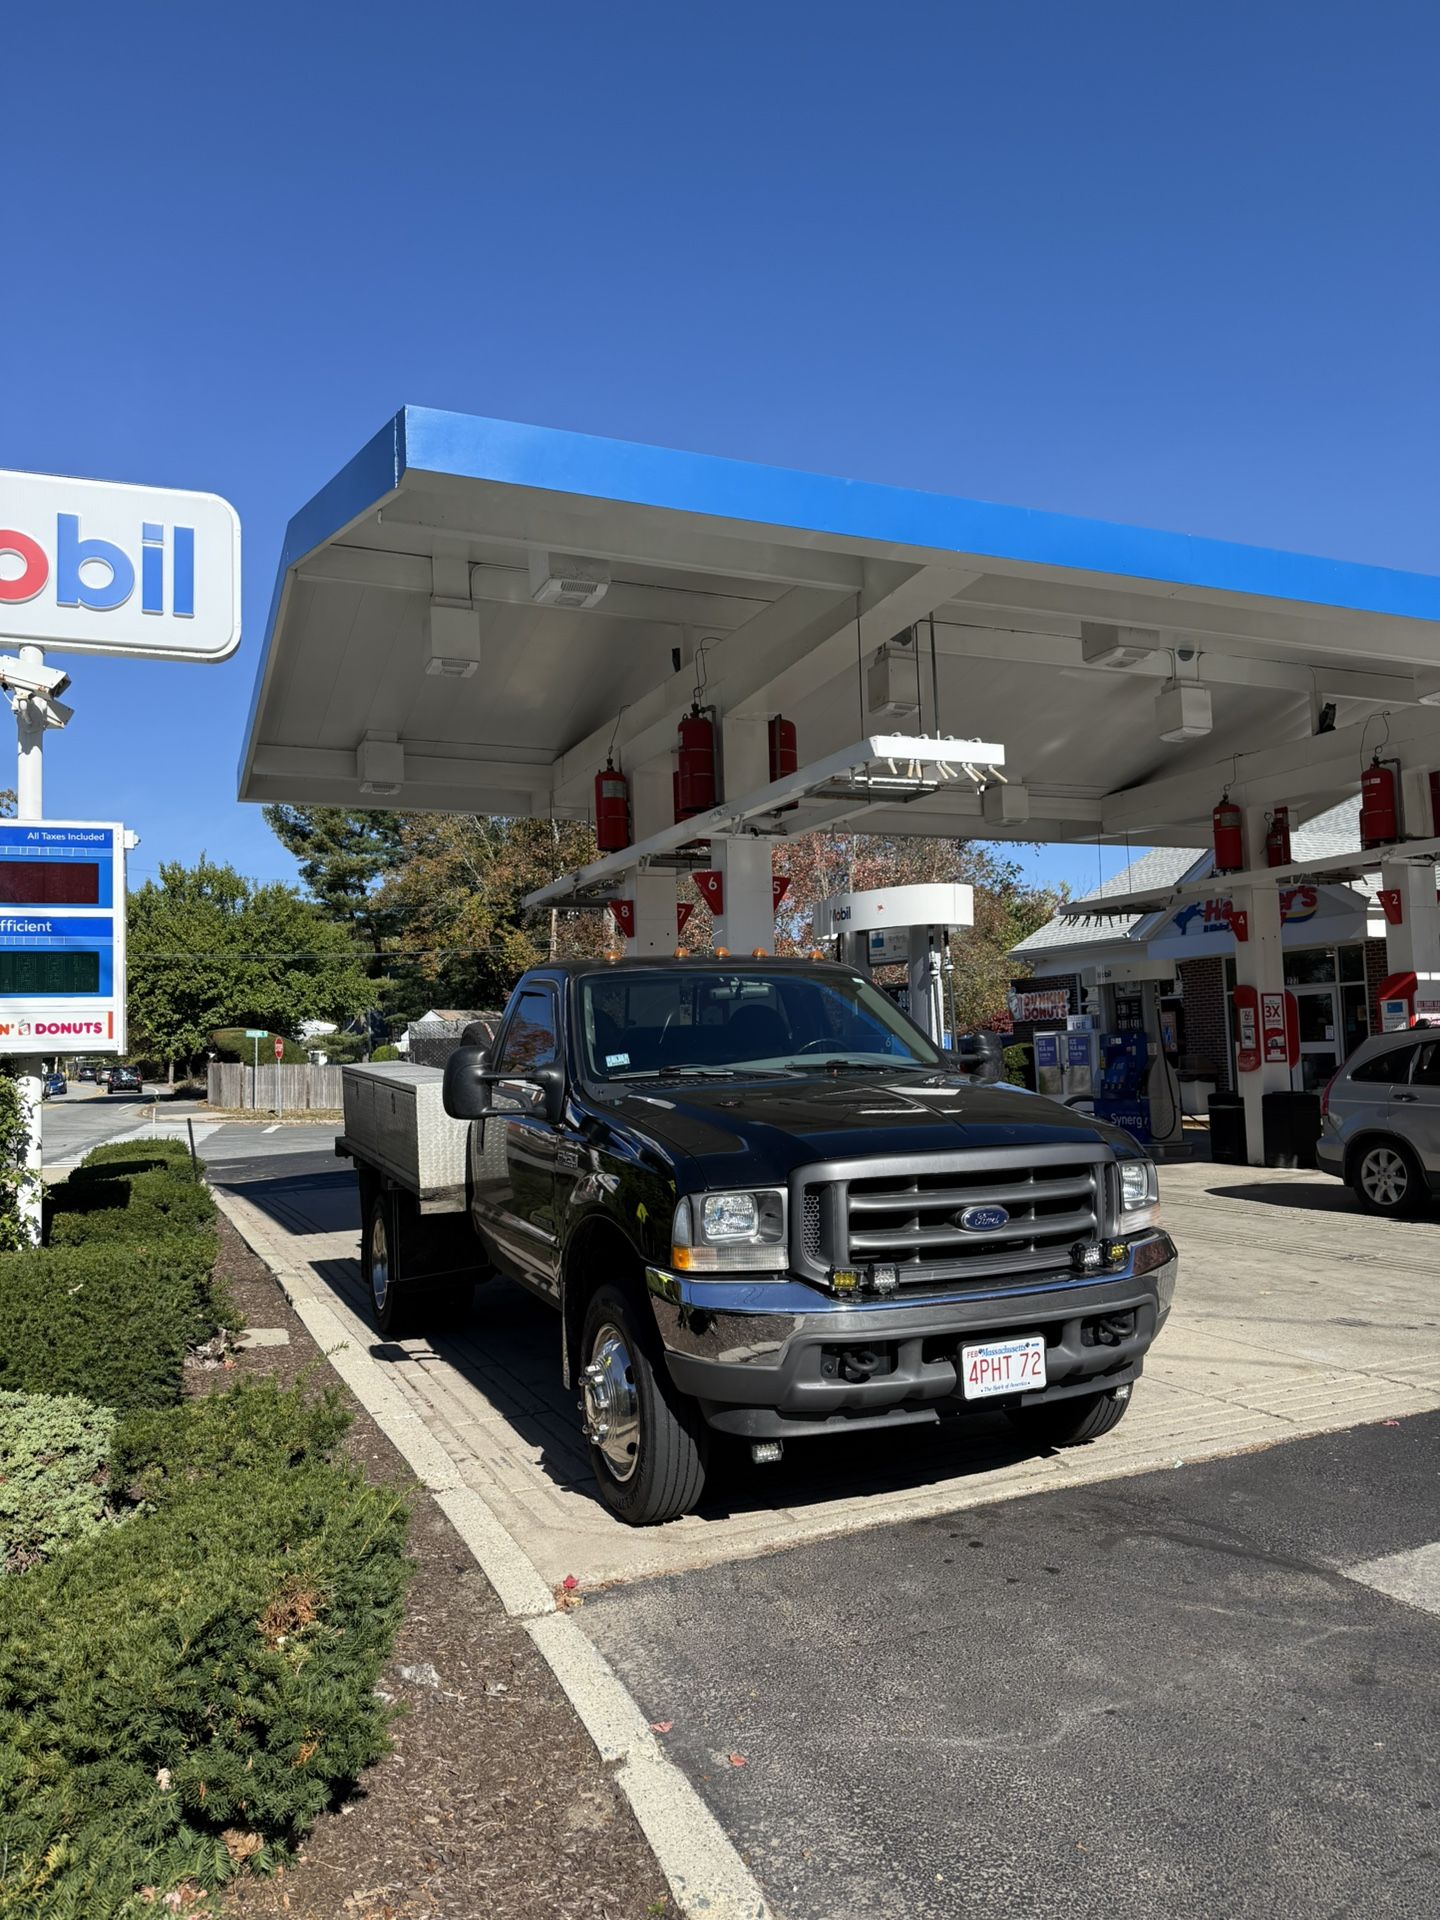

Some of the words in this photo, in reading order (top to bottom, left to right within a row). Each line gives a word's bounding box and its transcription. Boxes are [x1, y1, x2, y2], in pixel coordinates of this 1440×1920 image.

[27, 832, 39, 840] All
[41, 832, 66, 841] Taxes
[68, 832, 105, 841] Included
[708, 877, 717, 890] 6
[773, 881, 781, 895] 5
[1392, 893, 1399, 905] 2
[621, 906, 630, 918] 8
[678, 908, 685, 920] 7
[0, 919, 52, 932] fficient
[1238, 914, 1245, 925] 4
[1023, 990, 1068, 1007] DUNKIN'
[1023, 1004, 1067, 1021] DONUTS
[1265, 1005, 1281, 1018] 3X
[35, 1023, 103, 1035] DONUTS
[1072, 1021, 1087, 1030] ICE
[974, 1212, 1000, 1226] Ford
[982, 1345, 1026, 1356] Massachusetts
[969, 1355, 1012, 1384] 4PHT
[1020, 1351, 1041, 1378] 72
